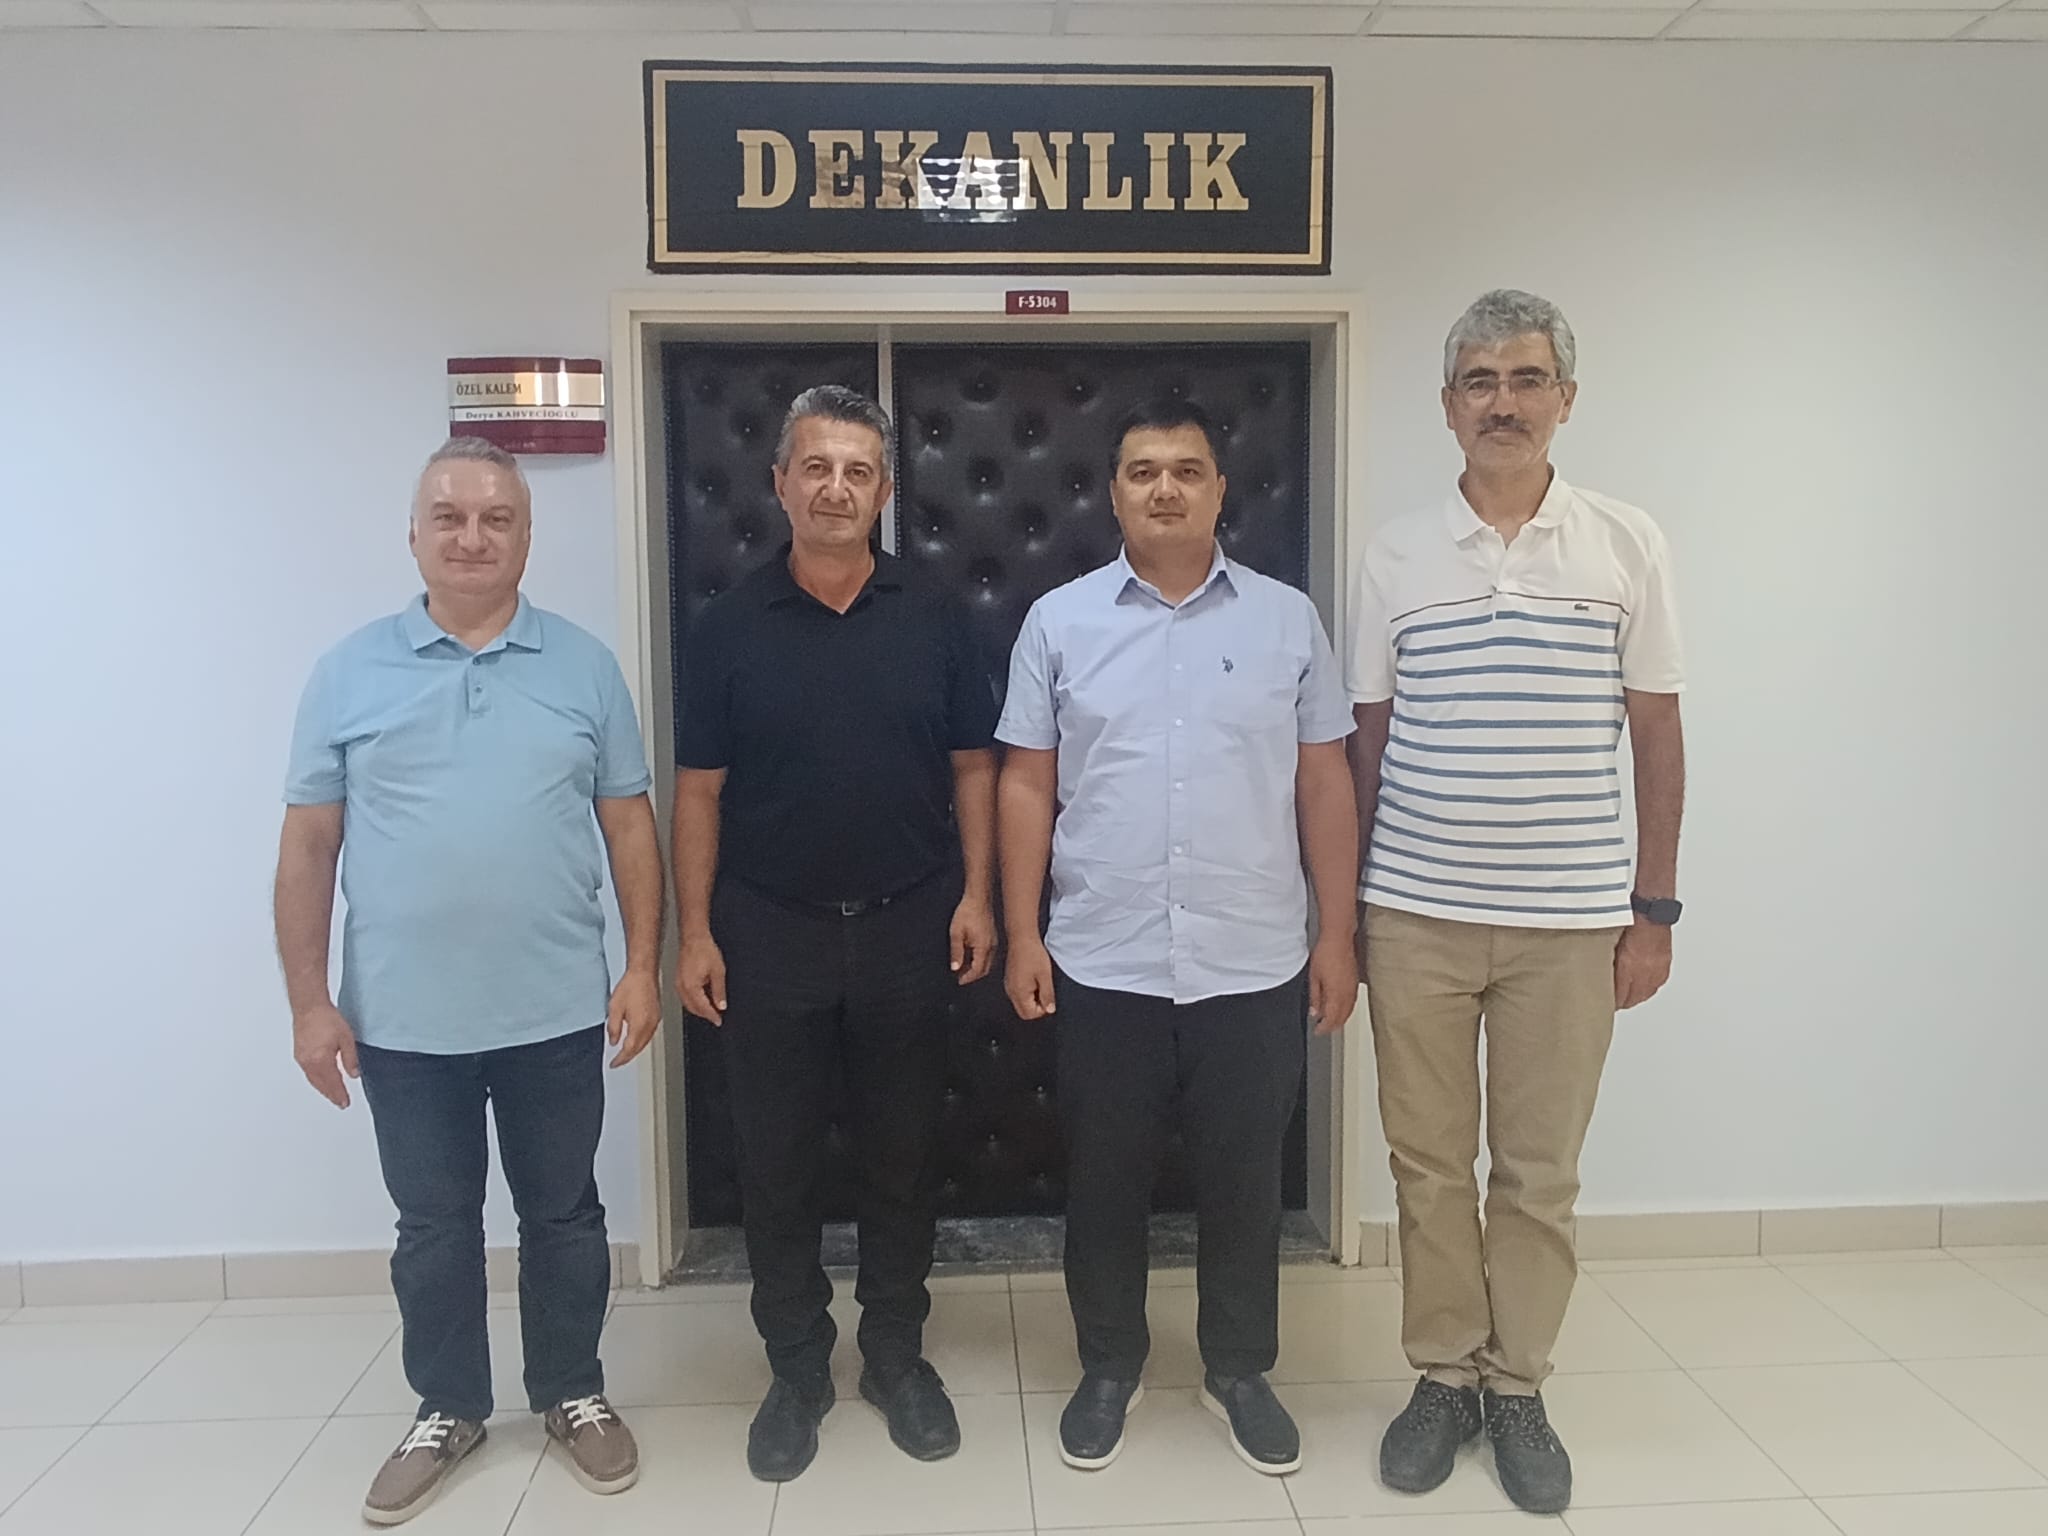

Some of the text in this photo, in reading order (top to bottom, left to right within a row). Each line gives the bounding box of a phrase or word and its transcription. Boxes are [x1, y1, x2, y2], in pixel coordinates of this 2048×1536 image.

[736, 129, 1250, 212] DEKANLIK
[1018, 295, 1057, 309] F-5304
[456, 381, 522, 396] ÖZEL KALEM
[466, 411, 494, 421] Derya
